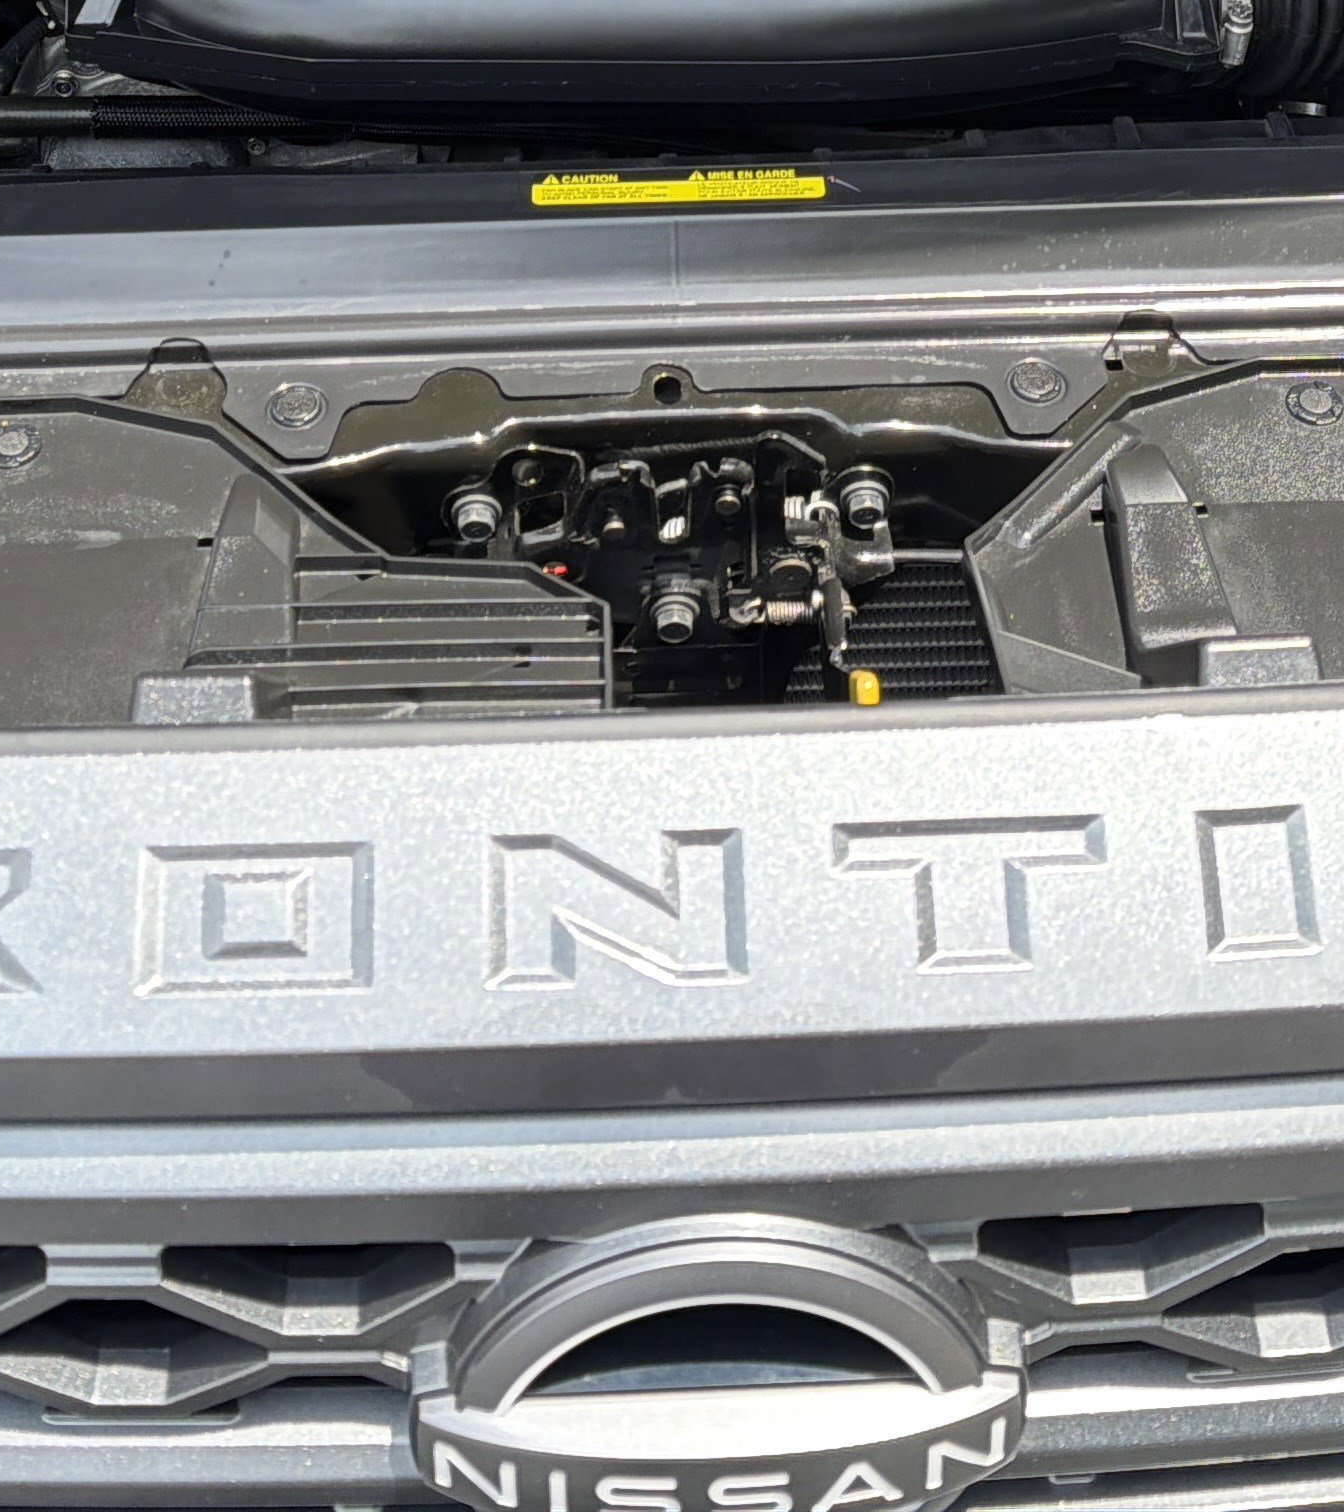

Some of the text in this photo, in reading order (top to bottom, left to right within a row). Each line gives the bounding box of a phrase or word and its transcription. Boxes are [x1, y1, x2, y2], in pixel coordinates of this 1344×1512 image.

[561, 173, 619, 185] CAUTION
[737, 170, 754, 180] EN
[755, 168, 796, 179] GARDE
[431, 1416, 1008, 1512] NISSAN
